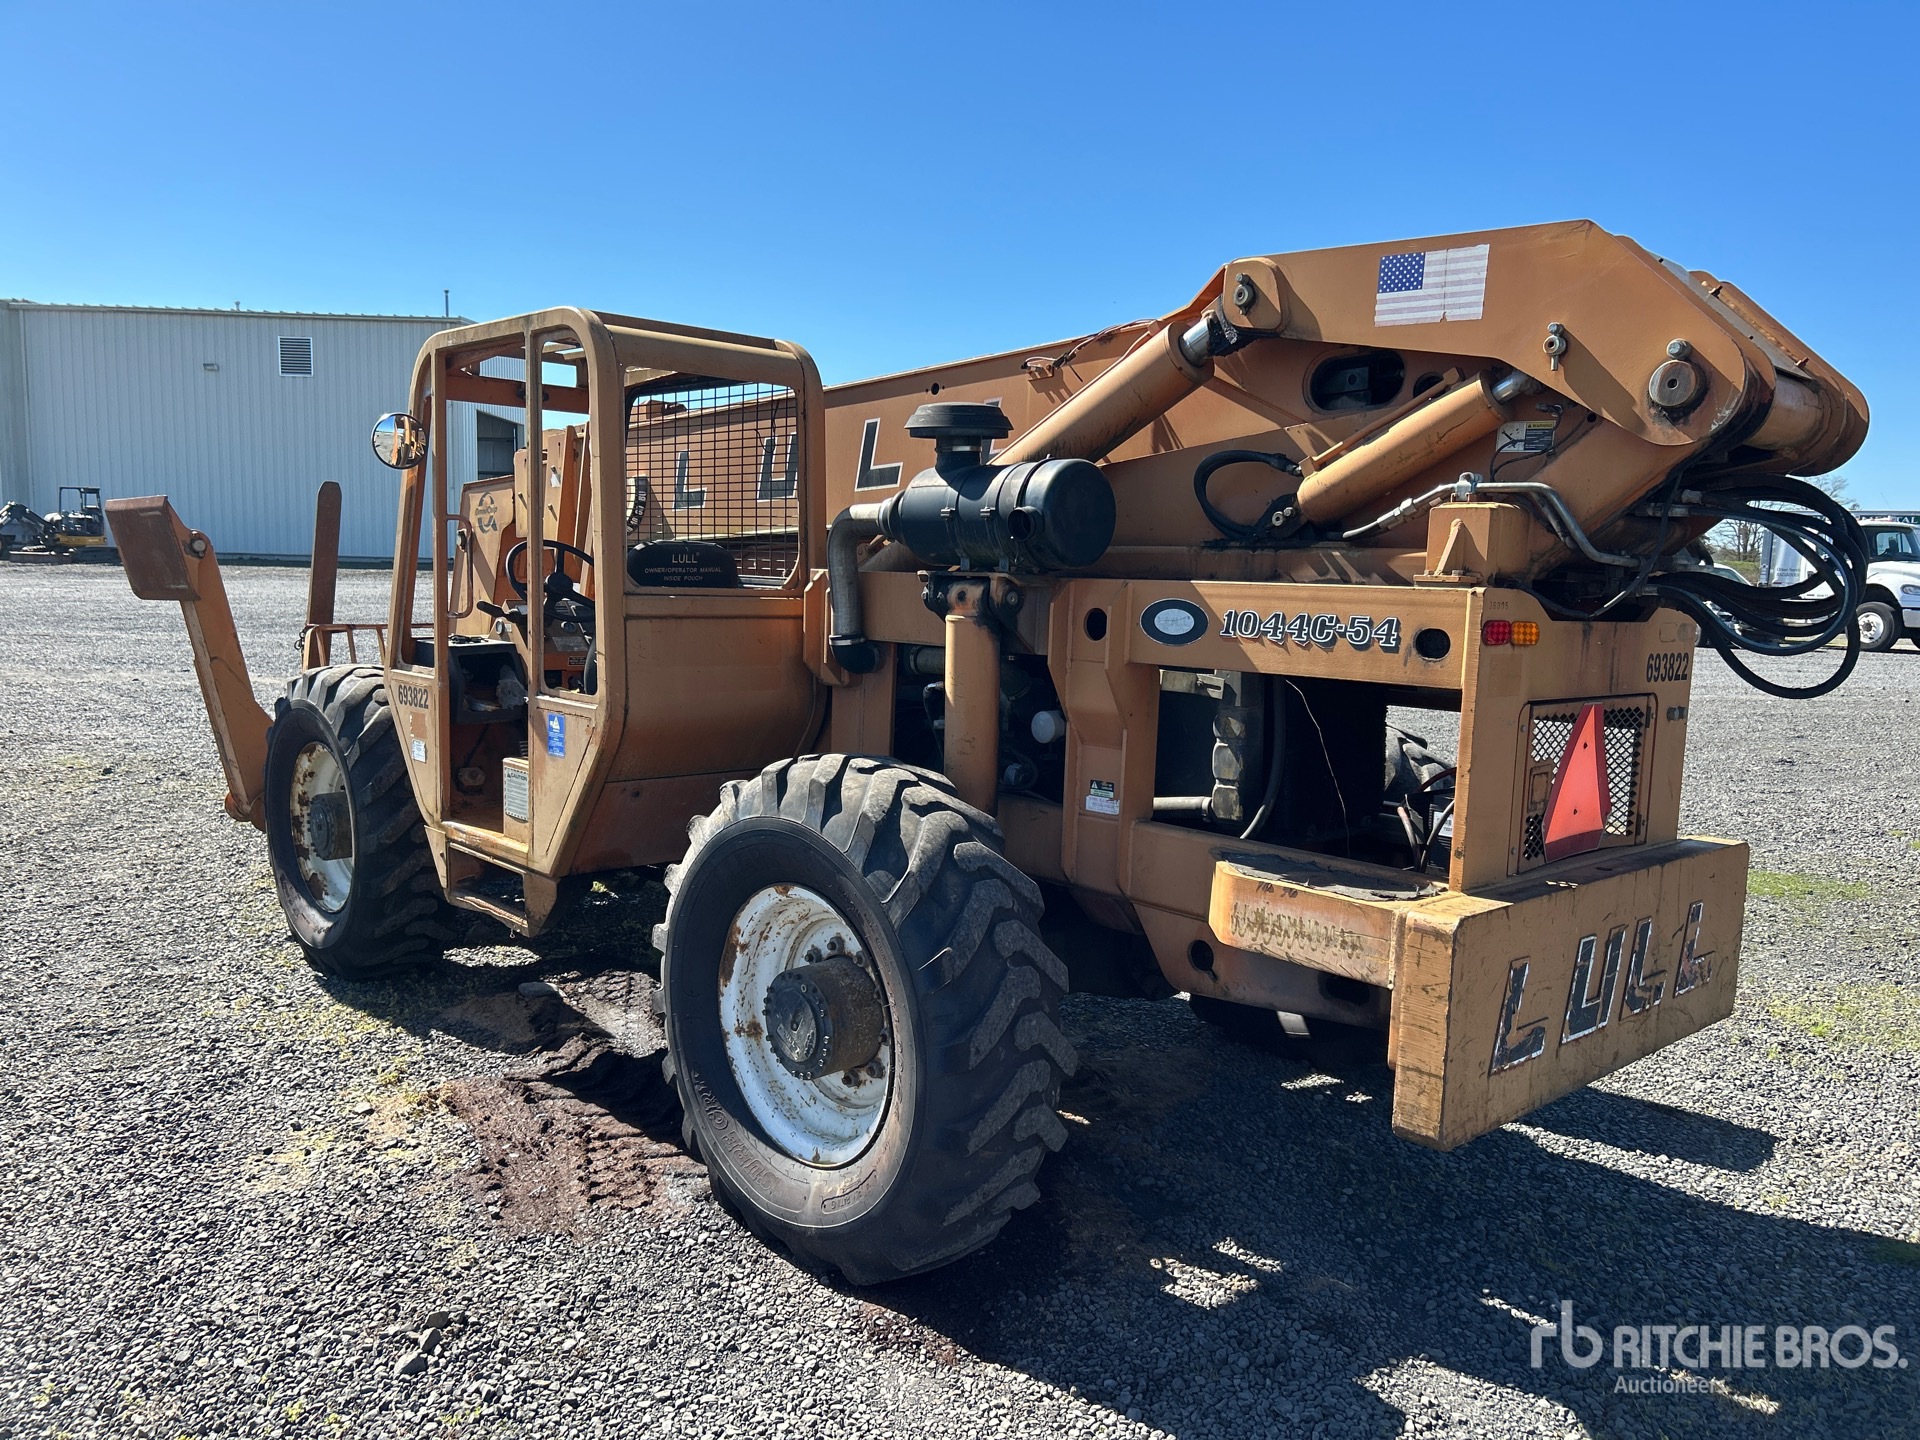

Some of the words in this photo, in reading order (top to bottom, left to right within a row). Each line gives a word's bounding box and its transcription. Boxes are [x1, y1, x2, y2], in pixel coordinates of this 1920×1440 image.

[1646, 652, 1689, 682] 693822
[398, 684, 428, 709] 693822
[1489, 902, 1713, 1077] LULL
